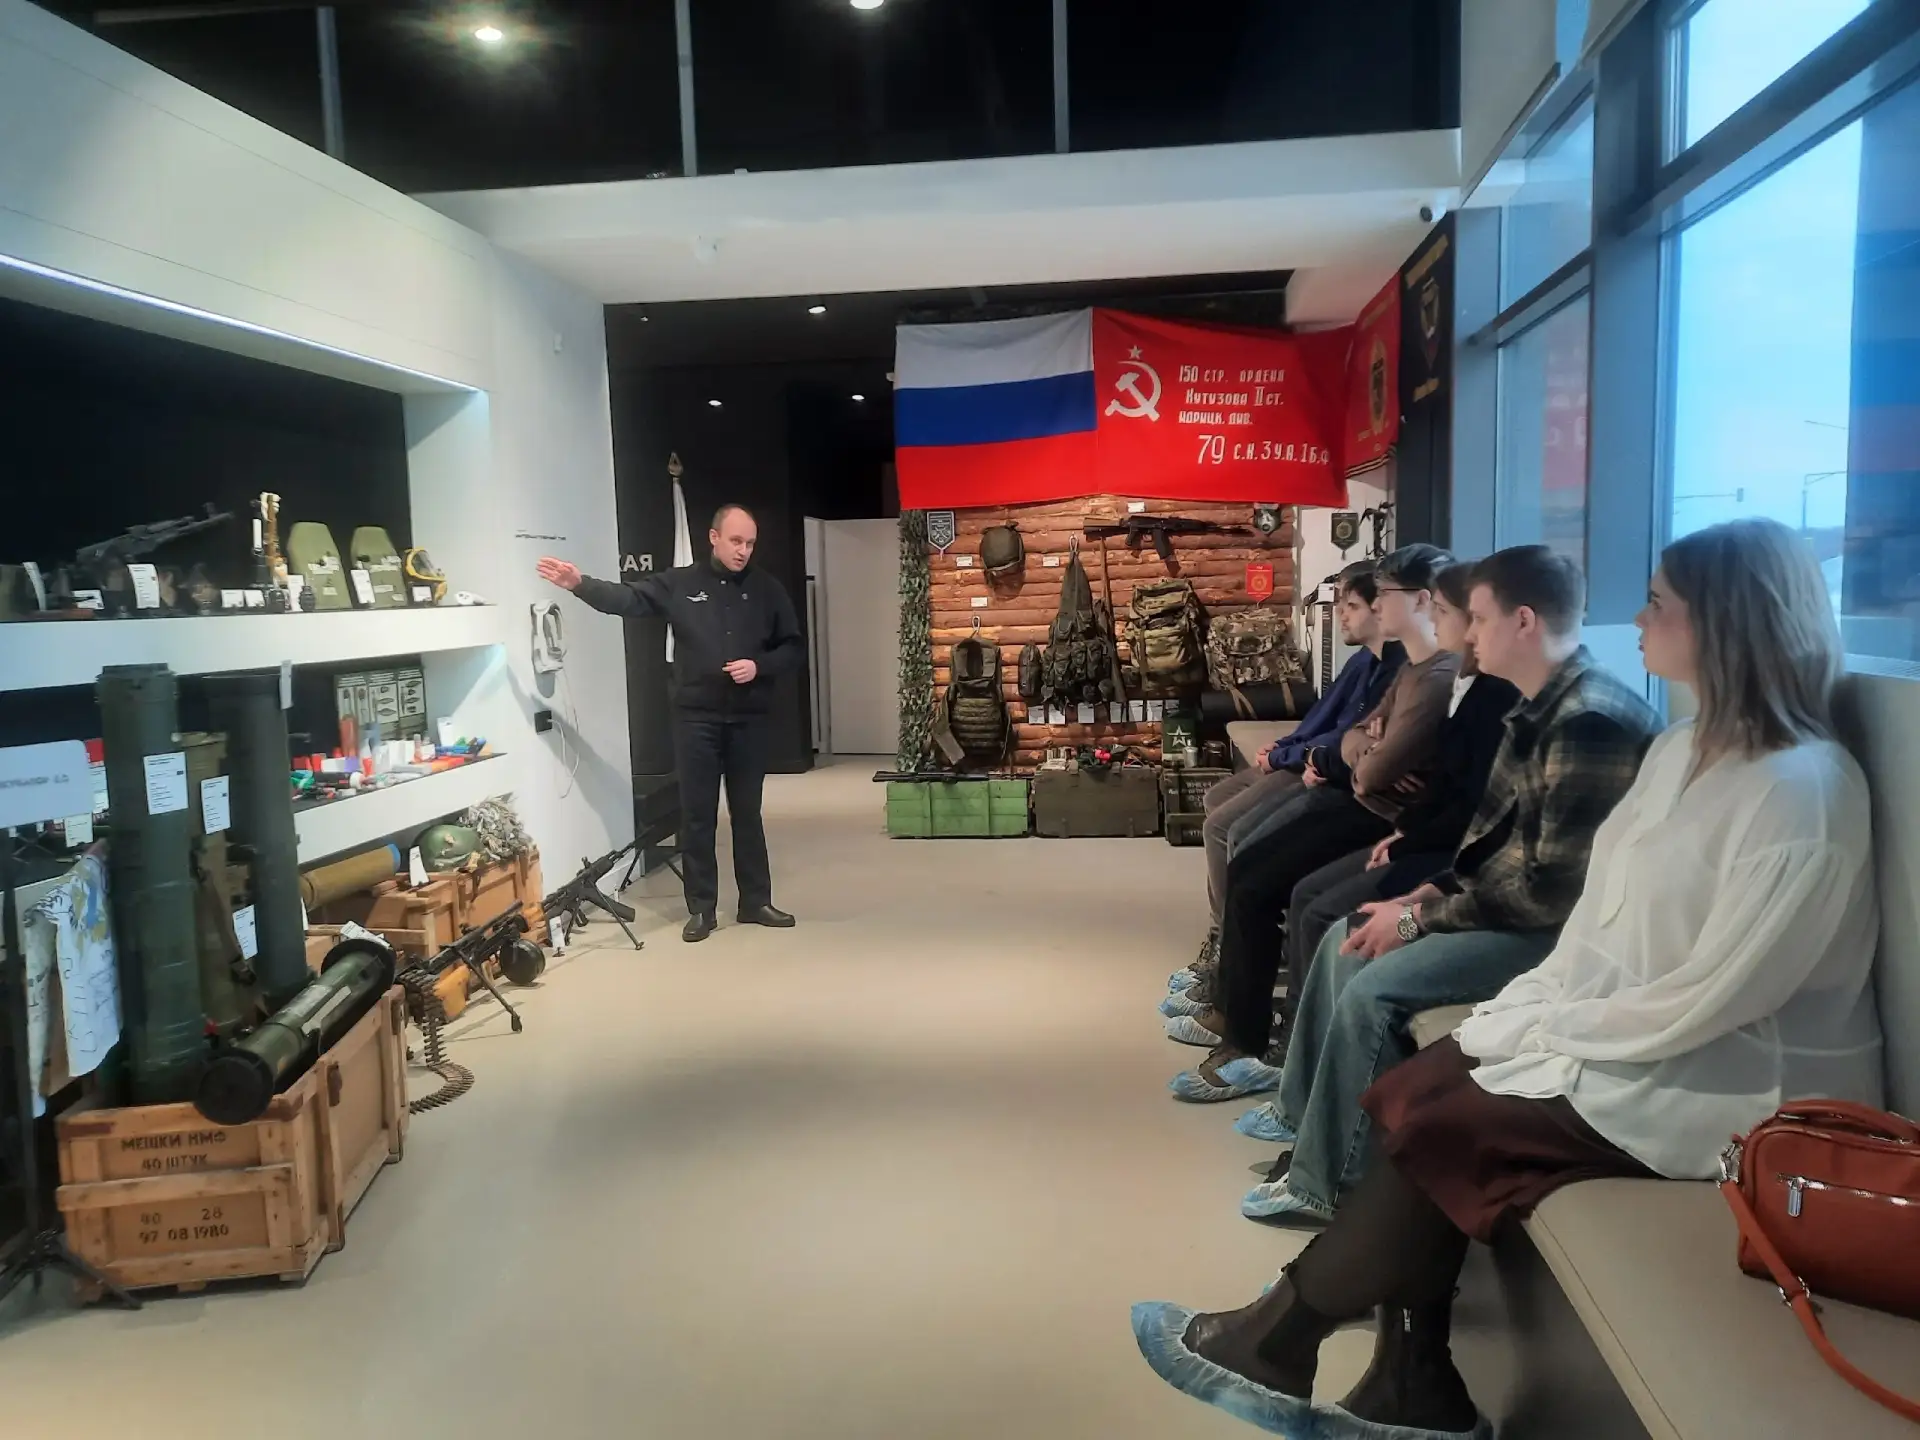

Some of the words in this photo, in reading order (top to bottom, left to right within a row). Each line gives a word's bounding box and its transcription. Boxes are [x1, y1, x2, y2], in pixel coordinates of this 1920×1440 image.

[1179, 365, 1199, 383] 150
[1198, 434, 1226, 465] 79
[619, 554, 653, 572] АЯ
[121, 1134, 181, 1151] МЕШКИ
[142, 1158, 162, 1170] 40
[165, 1153, 208, 1169] ШТУК
